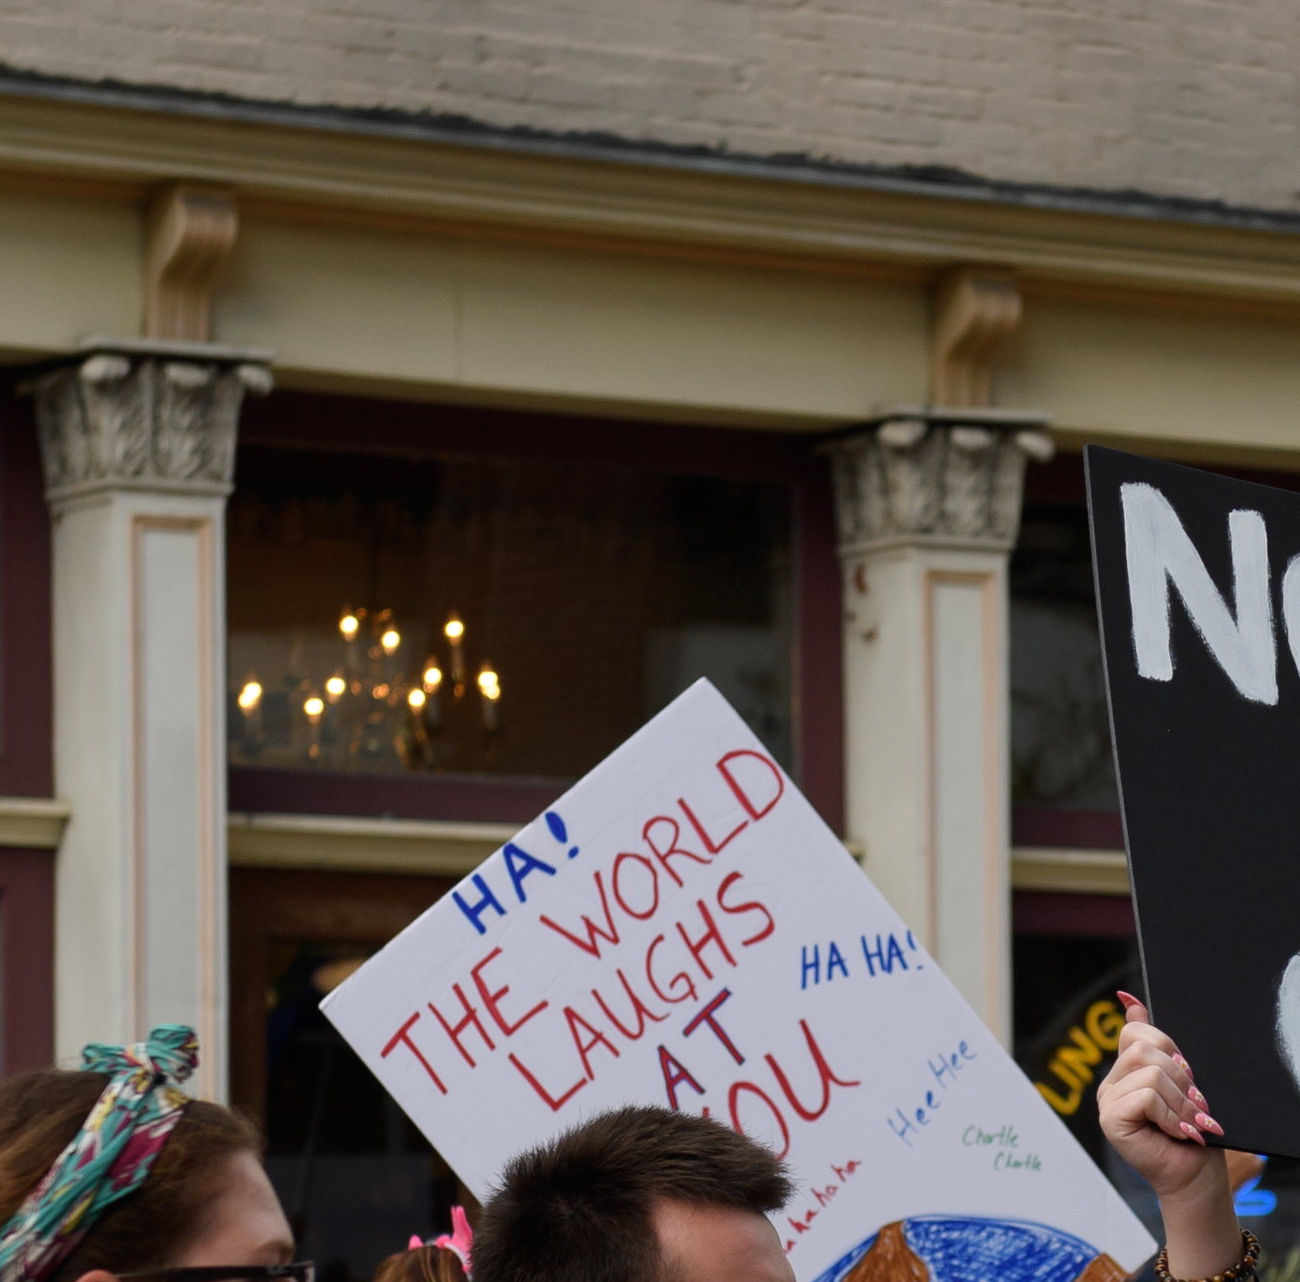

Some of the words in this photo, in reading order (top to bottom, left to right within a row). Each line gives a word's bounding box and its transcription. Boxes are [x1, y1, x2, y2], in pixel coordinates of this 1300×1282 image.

[380, 946, 549, 1095] THE
[539, 749, 785, 960] WORLD
[451, 811, 580, 935] HA!
[507, 870, 775, 1112] LAUGHS
[800, 941, 850, 990] HA
[860, 929, 925, 977] HA!
[656, 987, 746, 1112] AT
[702, 1018, 862, 1162] OU
[887, 1089, 942, 1148] Hee
[926, 1040, 979, 1089] Hee
[1034, 998, 1126, 1116] LING
